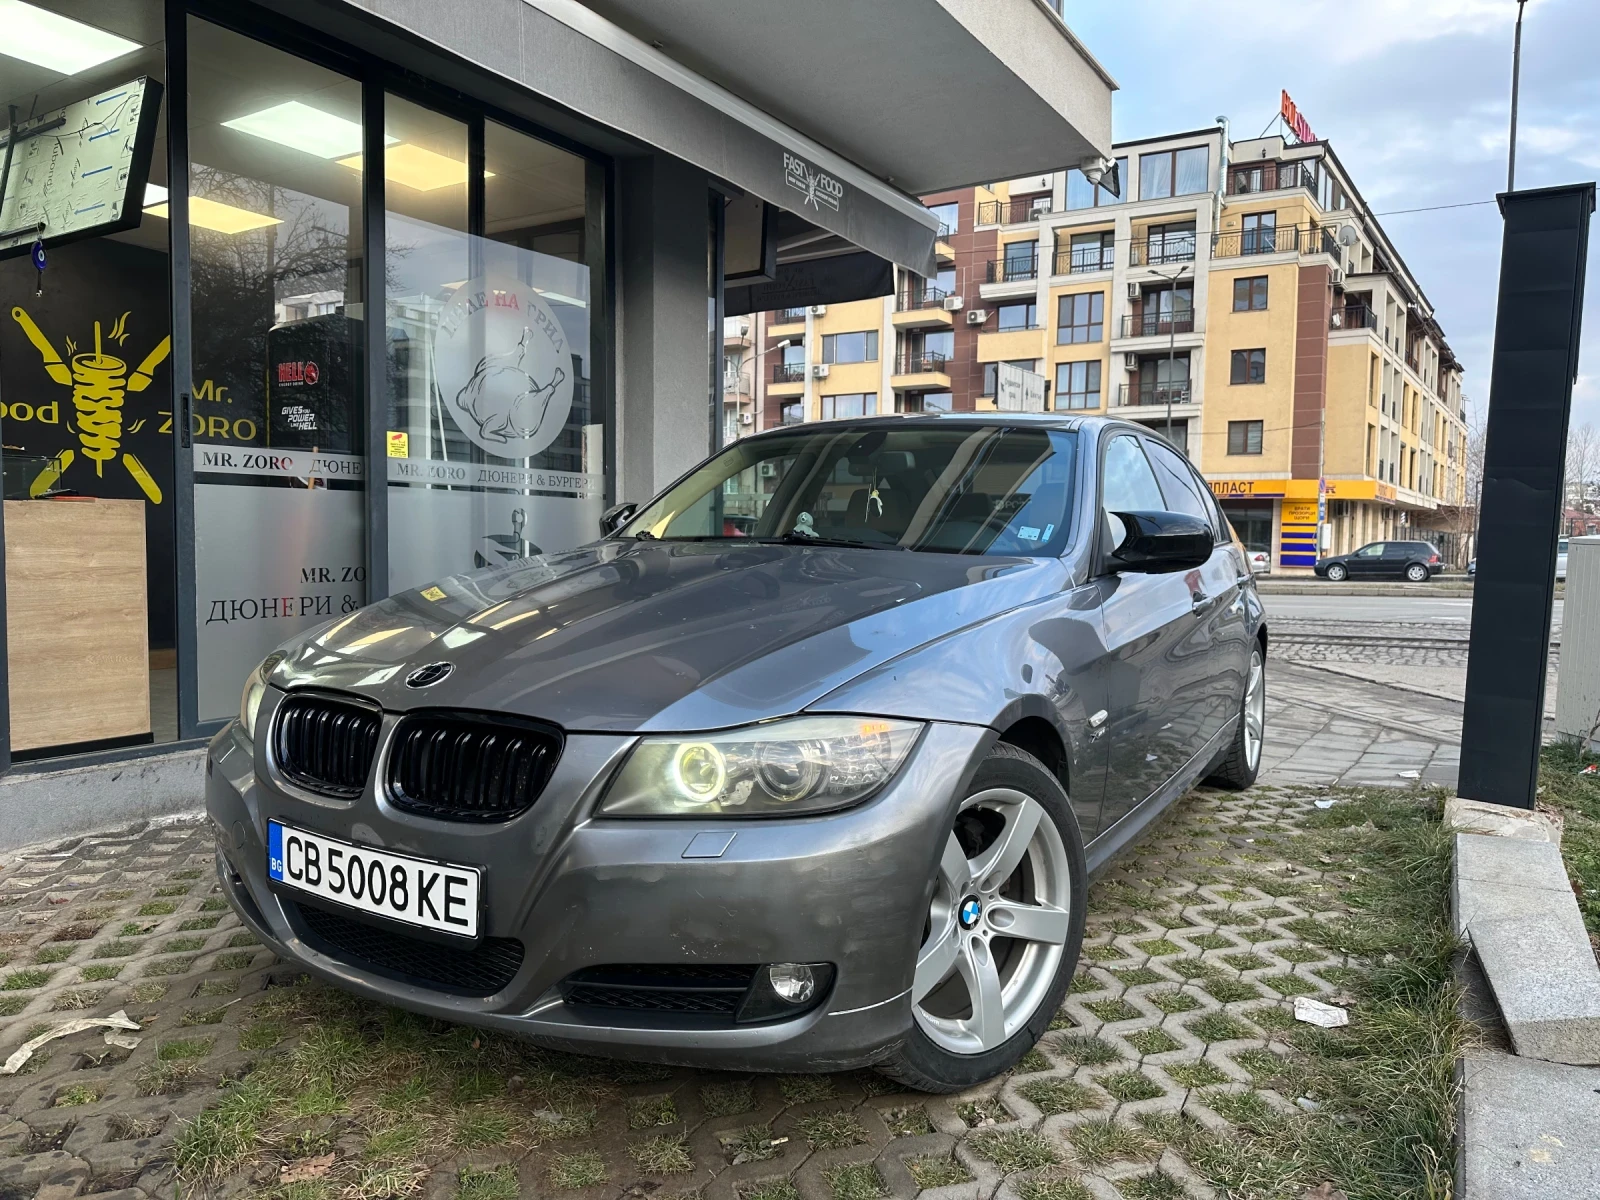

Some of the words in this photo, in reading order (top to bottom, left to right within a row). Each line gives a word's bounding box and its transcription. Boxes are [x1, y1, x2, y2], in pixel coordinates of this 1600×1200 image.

[783, 152, 806, 177] FAST
[820, 173, 843, 198] FOOD
[493, 293, 520, 311] НА
[526, 301, 564, 354] ГРИЛ
[278, 362, 304, 382] HELL
[192, 379, 233, 403] Mr.
[281, 406, 303, 415] GIVES
[287, 413, 315, 422] POWER
[299, 422, 317, 430] HELL
[202, 451, 238, 468] MR.
[242, 453, 293, 471] ZORO
[309, 459, 362, 475] ДЮНЕ
[396, 462, 423, 477] MR.
[427, 465, 466, 480] ZORO
[477, 469, 533, 485] ДЮНЕРИ
[536, 474, 546, 486] &
[548, 475, 595, 490] БУРГЕРИ
[300, 567, 336, 583] MR.
[341, 566, 366, 582] ZO
[205, 595, 333, 625] ДЮНЕРИ
[341, 594, 359, 614] &
[271, 857, 282, 873] BG
